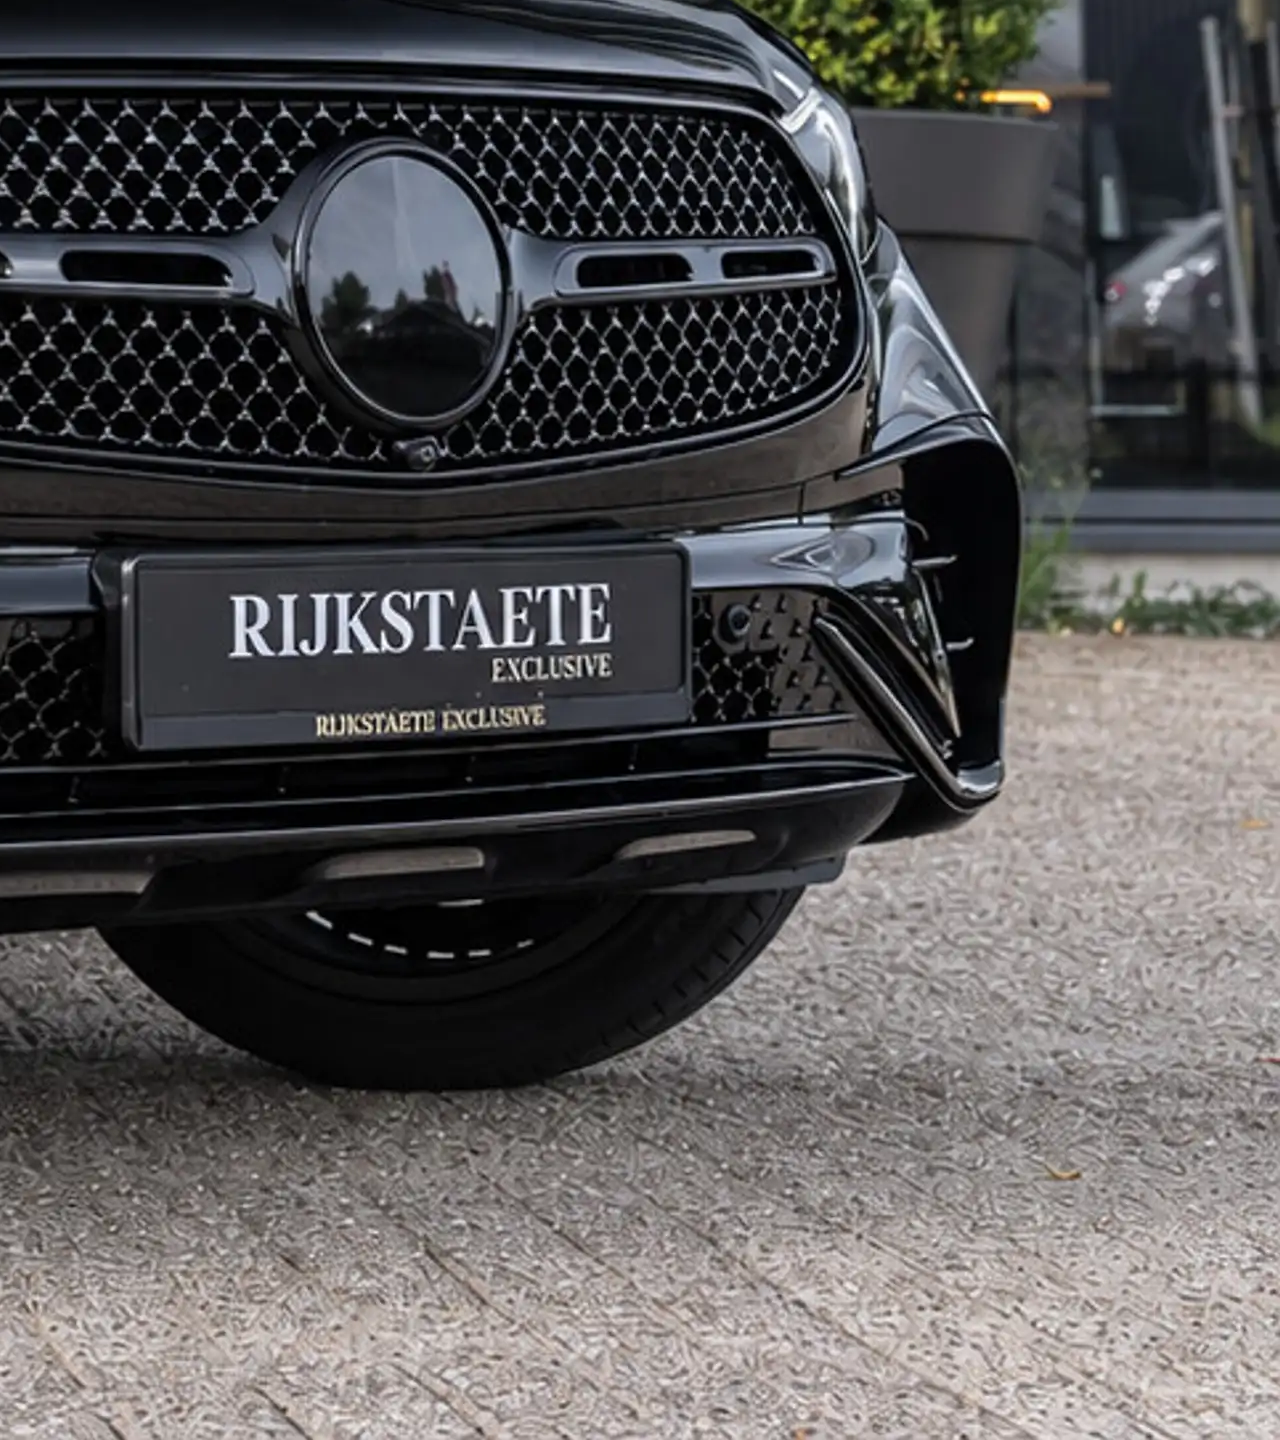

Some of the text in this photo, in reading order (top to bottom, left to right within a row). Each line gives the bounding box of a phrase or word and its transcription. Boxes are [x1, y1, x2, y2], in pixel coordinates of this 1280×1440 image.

[229, 583, 612, 658] RIJKSTAETE
[492, 654, 612, 682] EXCLUSIVE
[316, 705, 546, 737] RIJKSTAETE EXCLUSIVE
